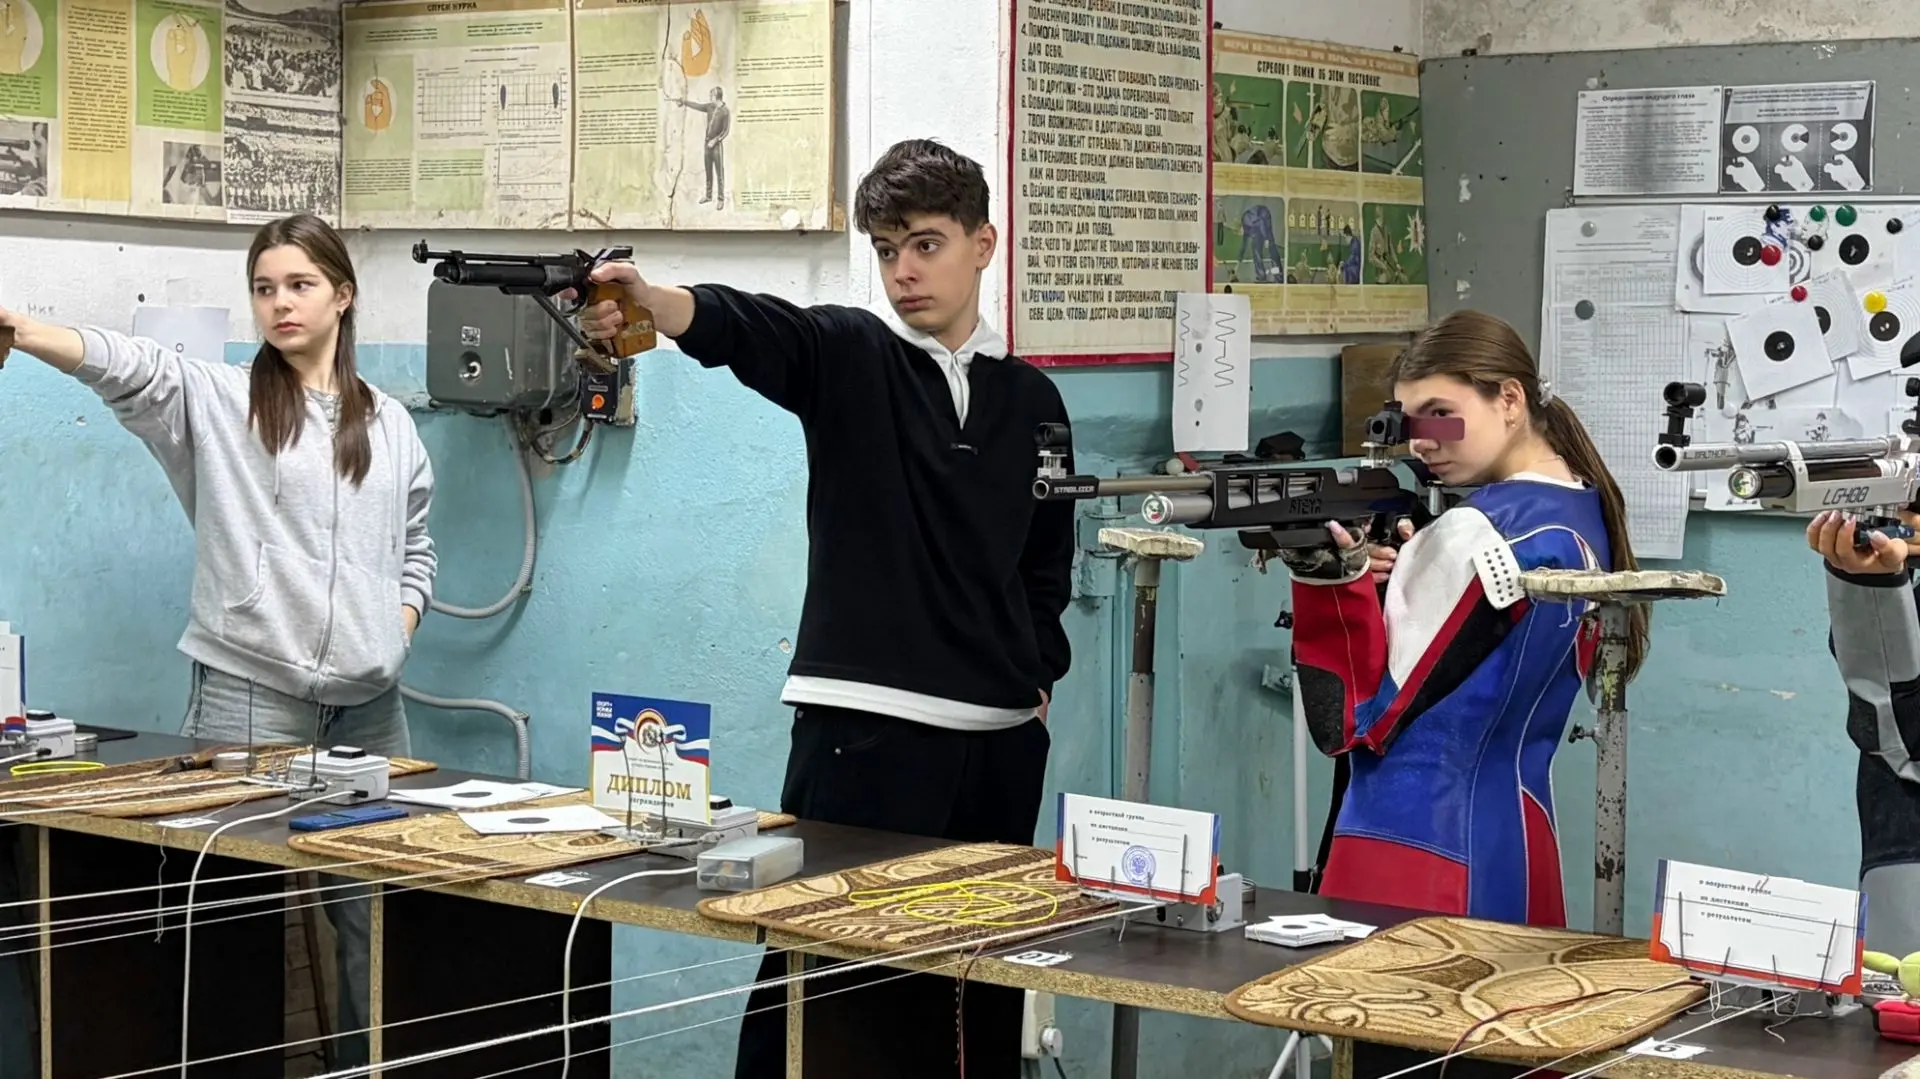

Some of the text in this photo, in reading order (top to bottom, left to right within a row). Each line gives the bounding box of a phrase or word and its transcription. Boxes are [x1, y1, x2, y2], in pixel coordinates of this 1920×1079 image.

[1028, 42, 1041, 56] ДЛЯ
[1328, 70, 1344, 82] ЭТОМ
[1027, 77, 1038, 92] ТЫ
[1029, 167, 1043, 180] КАК
[1046, 168, 1054, 180] НА
[1056, 186, 1068, 199] НЕТ
[1076, 222, 1090, 235] ДЛЯ
[1062, 238, 1072, 252] ТЫ
[1054, 486, 1095, 494] STABILIZER
[1822, 486, 1870, 506] LG400
[606, 772, 692, 800] ДИПЛОМ
